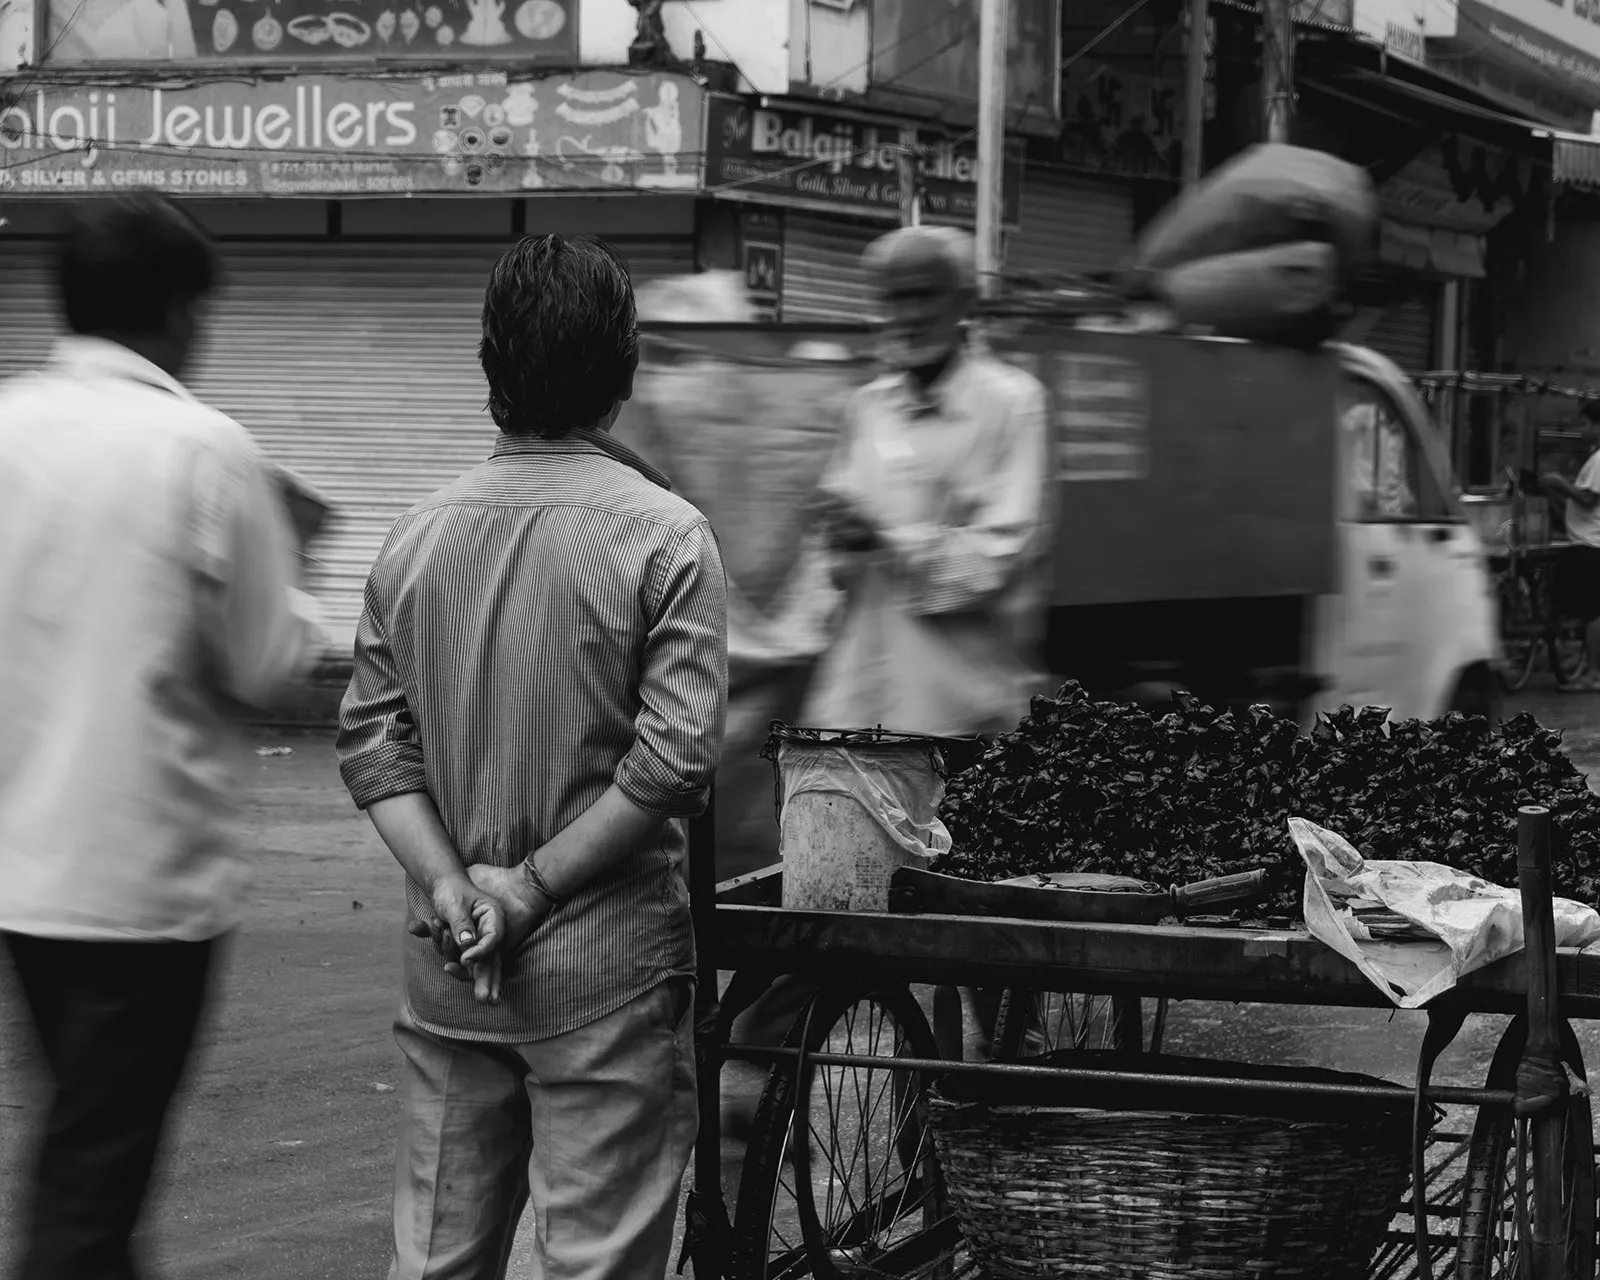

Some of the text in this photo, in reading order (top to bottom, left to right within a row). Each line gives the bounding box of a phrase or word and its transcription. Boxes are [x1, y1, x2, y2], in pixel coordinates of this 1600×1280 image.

[0, 86, 417, 167] alaji Jewellers
[752, 109, 853, 174] Balaji
[21, 169, 87, 186] SILVER
[92, 170, 106, 185] &
[111, 169, 165, 186] GEMS
[170, 169, 248, 186] STONES
